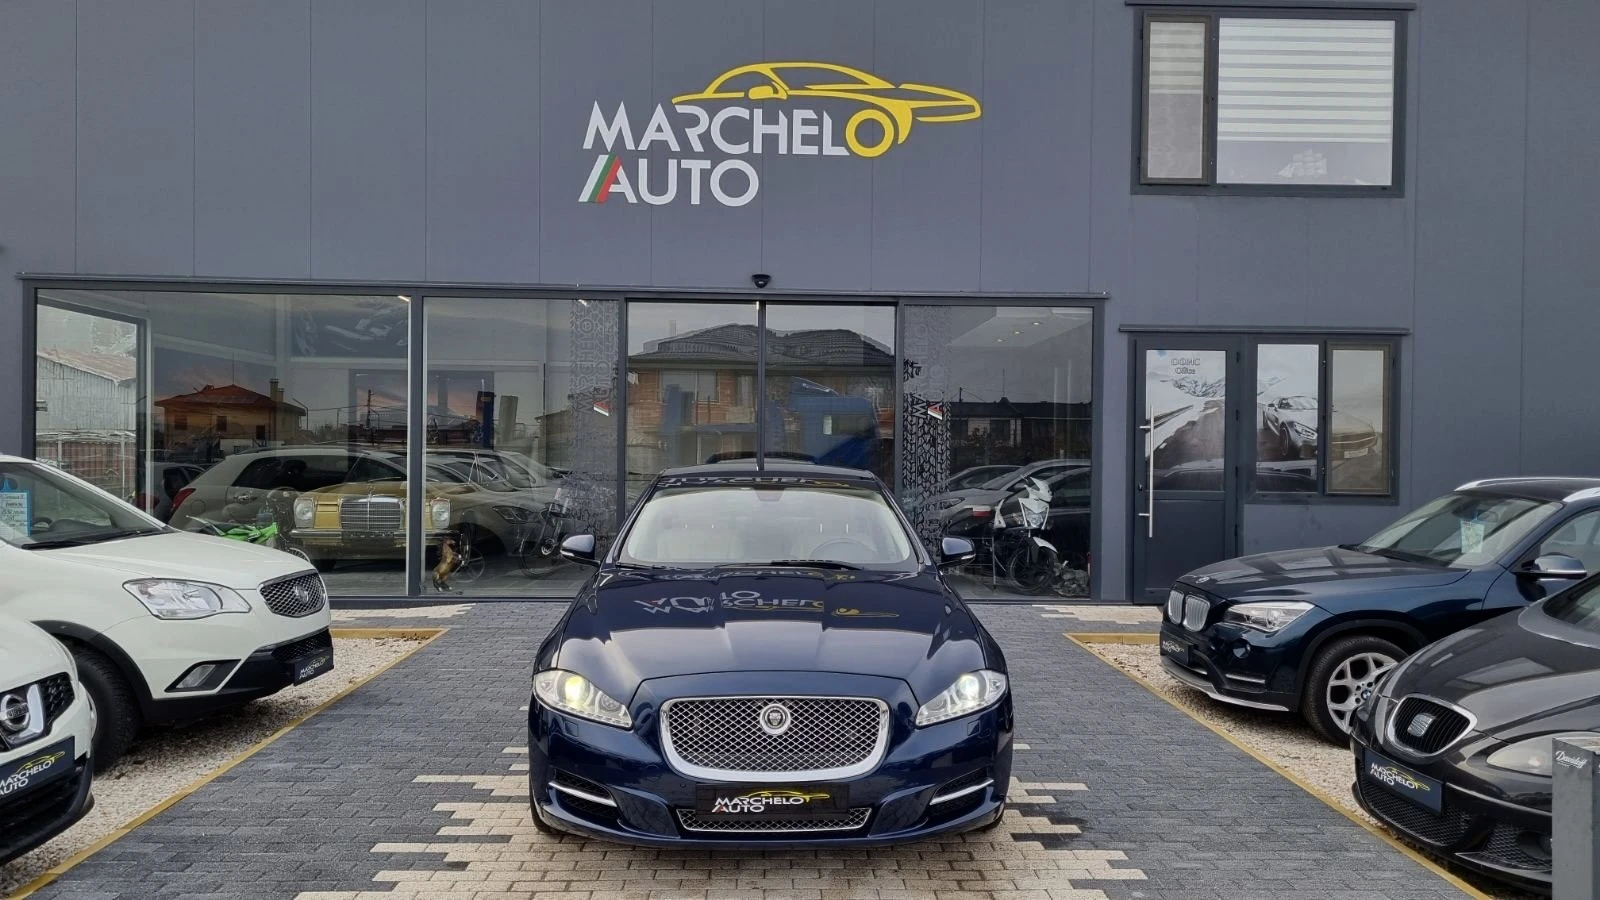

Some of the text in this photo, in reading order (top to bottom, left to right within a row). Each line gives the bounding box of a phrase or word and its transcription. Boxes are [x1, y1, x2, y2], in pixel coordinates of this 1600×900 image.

[582, 100, 895, 158] MARCHELO
[578, 153, 760, 207] AUTO
[1370, 768, 1395, 786] AUTO
[1371, 762, 1415, 789] MARCHELO
[711, 804, 765, 813] AUTO
[714, 796, 804, 805] MARCHELO
